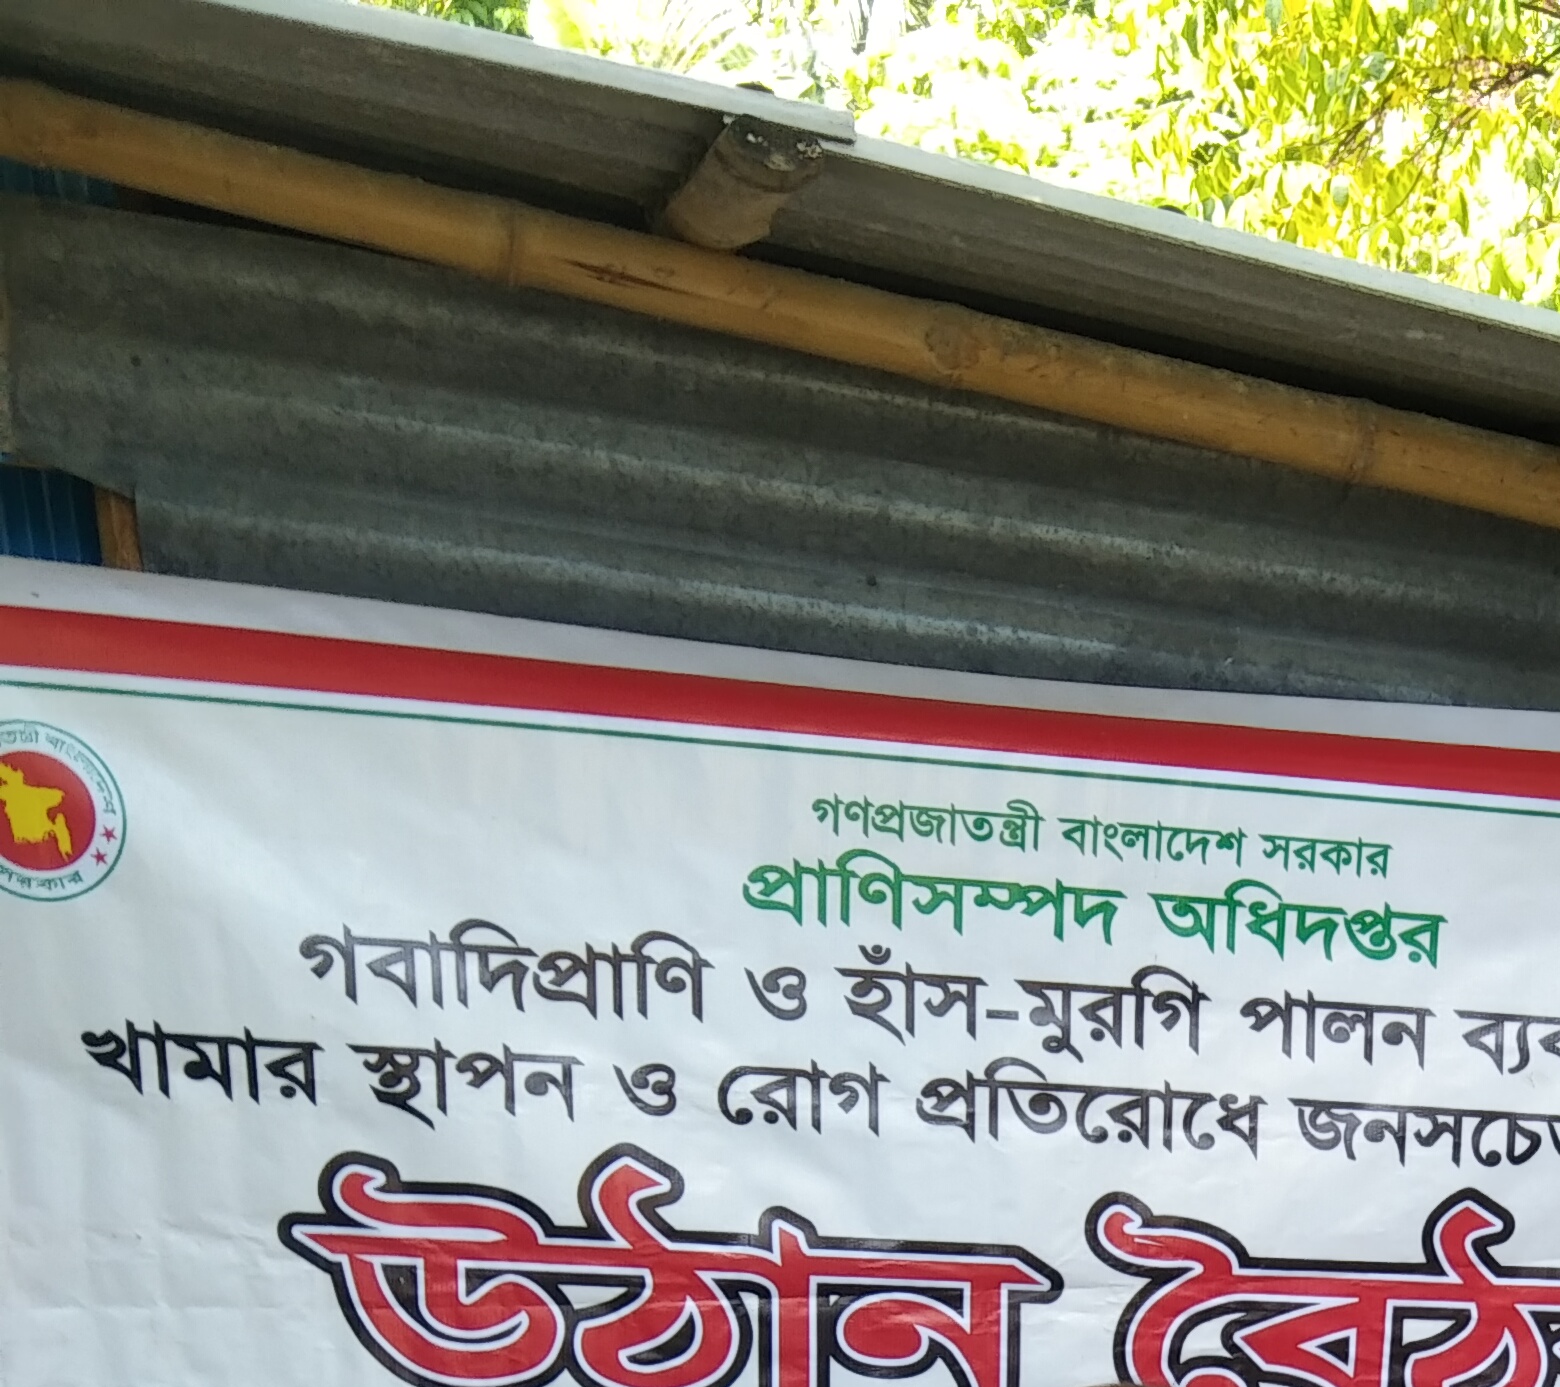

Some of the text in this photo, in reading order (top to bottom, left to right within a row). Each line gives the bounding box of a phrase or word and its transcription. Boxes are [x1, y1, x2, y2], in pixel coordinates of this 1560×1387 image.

[812, 793, 1392, 878] গণপ্রজাতন্ত্রী বাংলাদেশ সরকার
[743, 849, 1448, 969] প্রাণিসম্পদ অধিদপ্তর
[299, 919, 715, 1023] গবাদিপ্রাণি
[744, 967, 807, 1021] ও
[834, 944, 1212, 1063] হাঁস-মুরগি
[1240, 990, 1436, 1070] পালন
[81, 1019, 325, 1106] খামার
[346, 1038, 584, 1131] স্থাপন
[613, 1063, 677, 1116] ও
[718, 1058, 891, 1137] রোগ
[916, 1057, 1268, 1159] প্রতিরোধে
